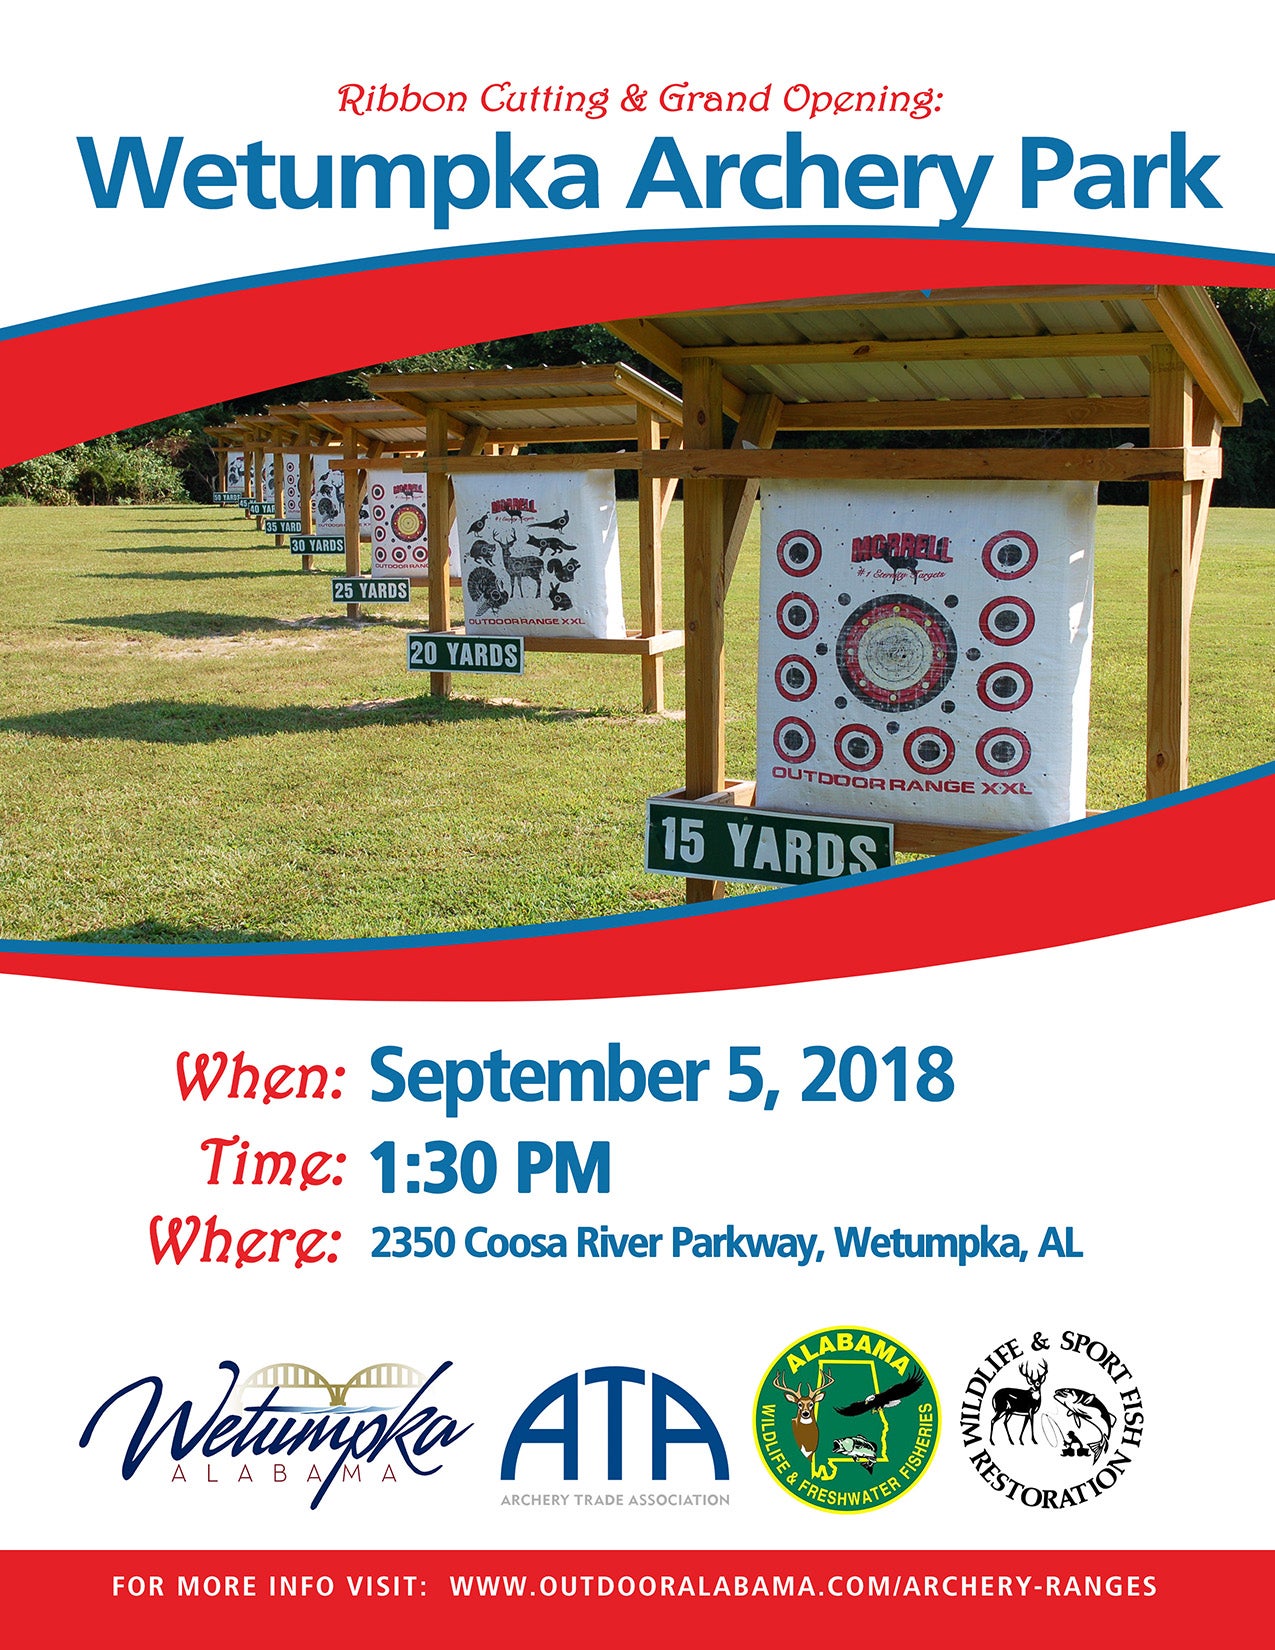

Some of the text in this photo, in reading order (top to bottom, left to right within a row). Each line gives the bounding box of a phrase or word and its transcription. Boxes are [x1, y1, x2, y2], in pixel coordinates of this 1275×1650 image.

[338, 81, 943, 120] Ribbon Cutting & Grand Opening:
[76, 131, 1223, 229] Wetumpka Archery Park
[250, 505, 259, 514] 40
[266, 522, 302, 532] 35 YARD
[292, 539, 344, 552] 30 YARDS
[850, 532, 953, 564] MORRELL
[335, 583, 407, 599] 25 YARDS
[410, 640, 517, 667] 20 YARDS
[771, 766, 885, 790] OUTDOOR
[889, 779, 975, 794] RANGE
[662, 816, 878, 878] 15 YARDS
[176, 1042, 954, 1118] When: September 5, 2018
[201, 1135, 610, 1194] Time: 1:30 PM
[150, 1215, 1084, 1269] Where: 2350 Coosa River Parkway, Wetumpka, AL
[786, 1332, 911, 1377] ALABAMA
[960, 1330, 1144, 1448] WILDLIFE & SPORT FISH
[79, 1360, 475, 1511] Wetumpka
[500, 1366, 729, 1480] ATA
[171, 1463, 397, 1483] ALABAMA
[760, 1402, 933, 1506] WILDLIFE & FRESHWATER FISHERIES
[501, 1494, 730, 1506] ARCHERY TRADE ASSOCIATION
[969, 1449, 1132, 1509] RESTORATION
[113, 1575, 1157, 1597] FOR MORE INFO VISIT: WWW.OUTDOORALABAMA.COM/ARCHERY-RANGES
